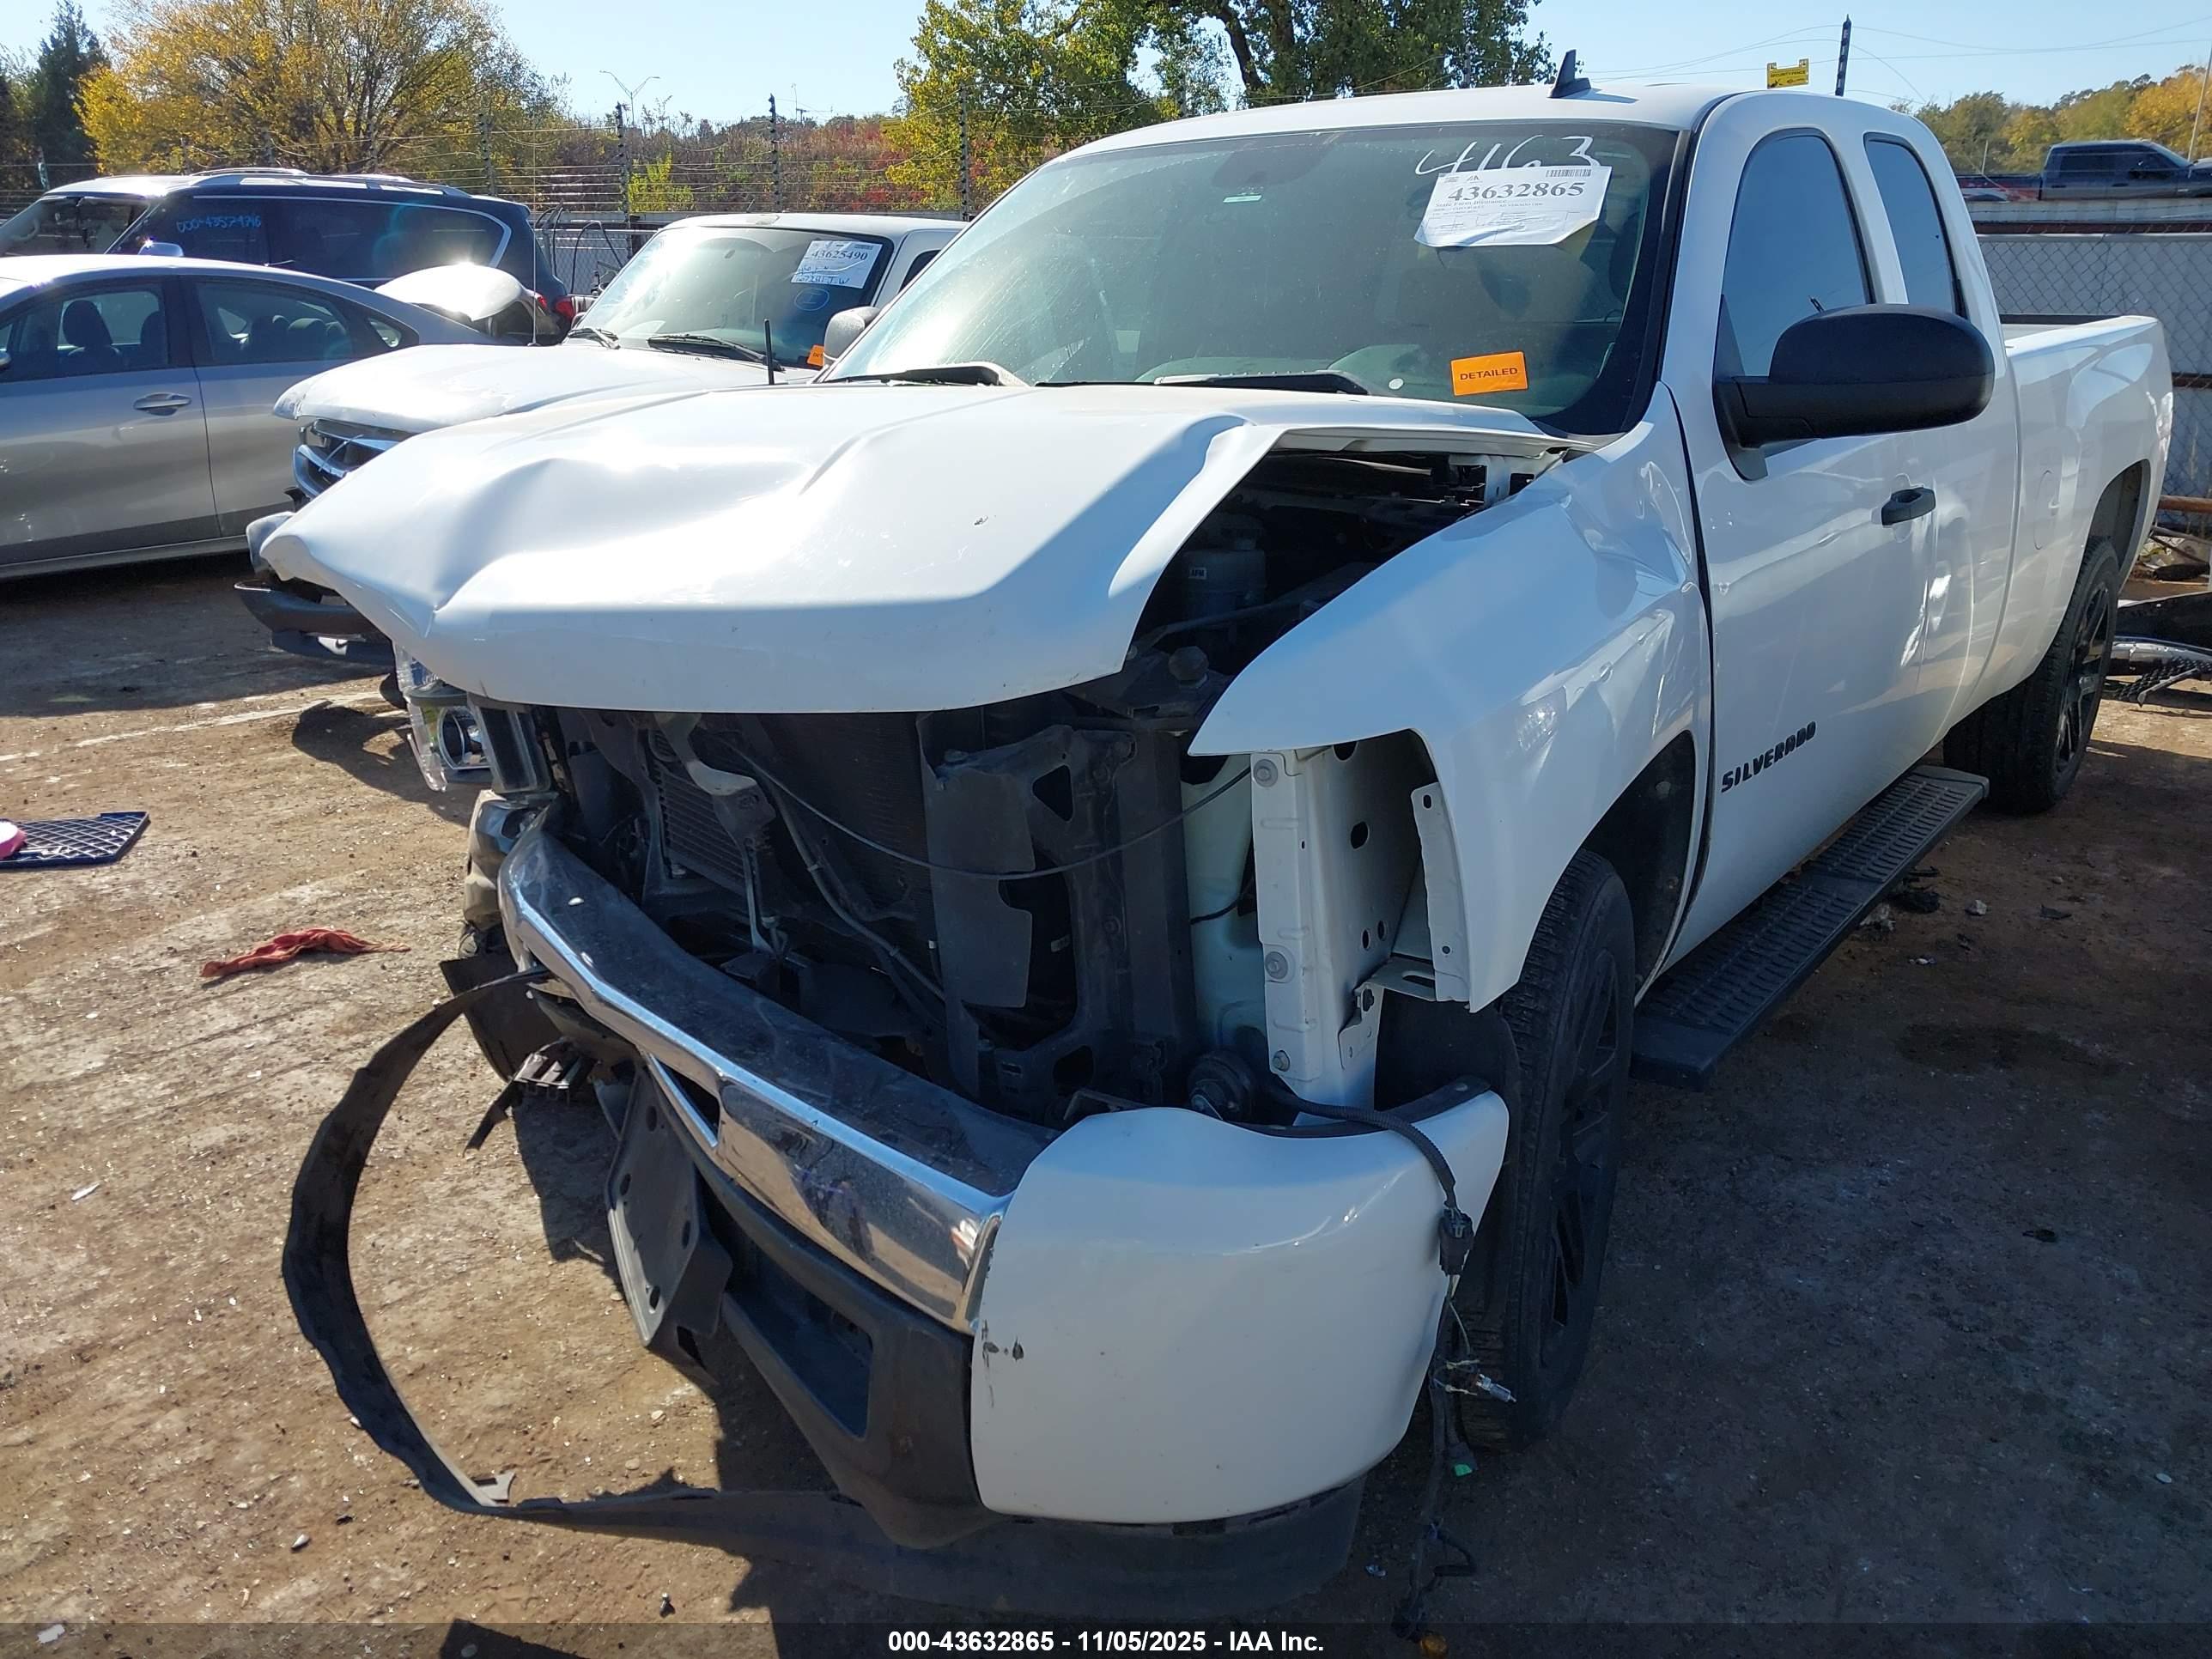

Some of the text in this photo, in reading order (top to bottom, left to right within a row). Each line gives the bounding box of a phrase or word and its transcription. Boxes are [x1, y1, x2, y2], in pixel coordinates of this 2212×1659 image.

[1448, 182, 1585, 201] 43632865
[811, 249, 868, 260] 43625490
[1460, 368, 1518, 380] DETAILED
[1721, 721, 1816, 793] SILVERADO
